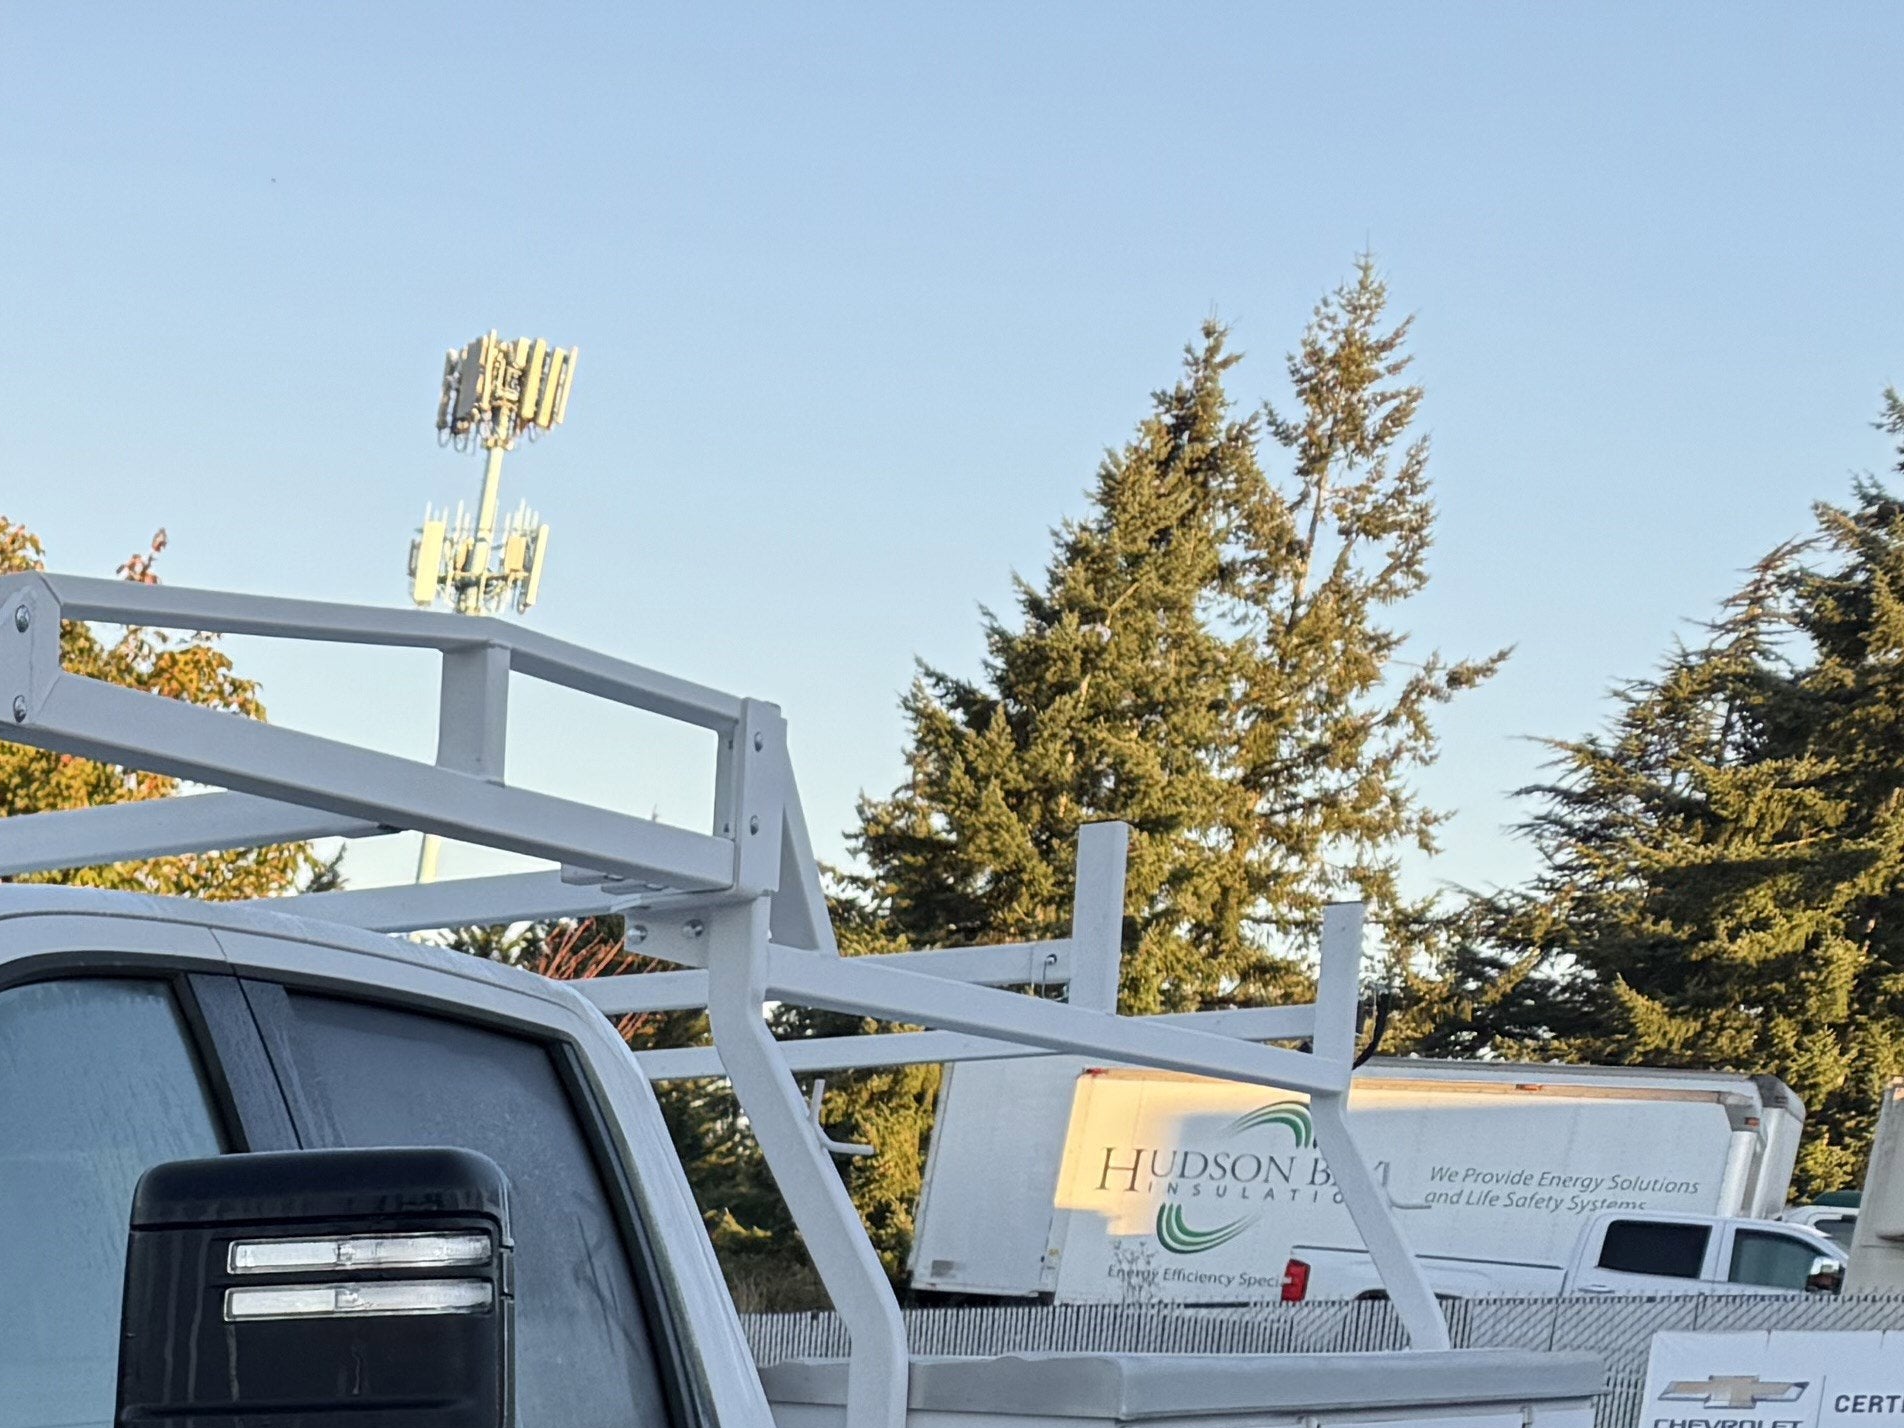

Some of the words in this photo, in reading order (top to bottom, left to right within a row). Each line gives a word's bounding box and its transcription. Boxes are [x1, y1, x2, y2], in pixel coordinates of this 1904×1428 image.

[1095, 1147, 1295, 1192] HUDSON
[1430, 1166, 1459, 1182] We
[1463, 1167, 1534, 1186] Provide
[1538, 1171, 1603, 1193] Energy
[1608, 1175, 1699, 1194] Solutions
[1148, 1181, 1344, 1204] INSULATIO
[1425, 1189, 1463, 1205] and
[1466, 1190, 1500, 1206] Life
[1502, 1192, 1564, 1213] Safety
[1108, 1264, 1159, 1286] Energy
[1163, 1268, 1235, 1287] Efficiency
[1239, 1272, 1284, 1288] Speci
